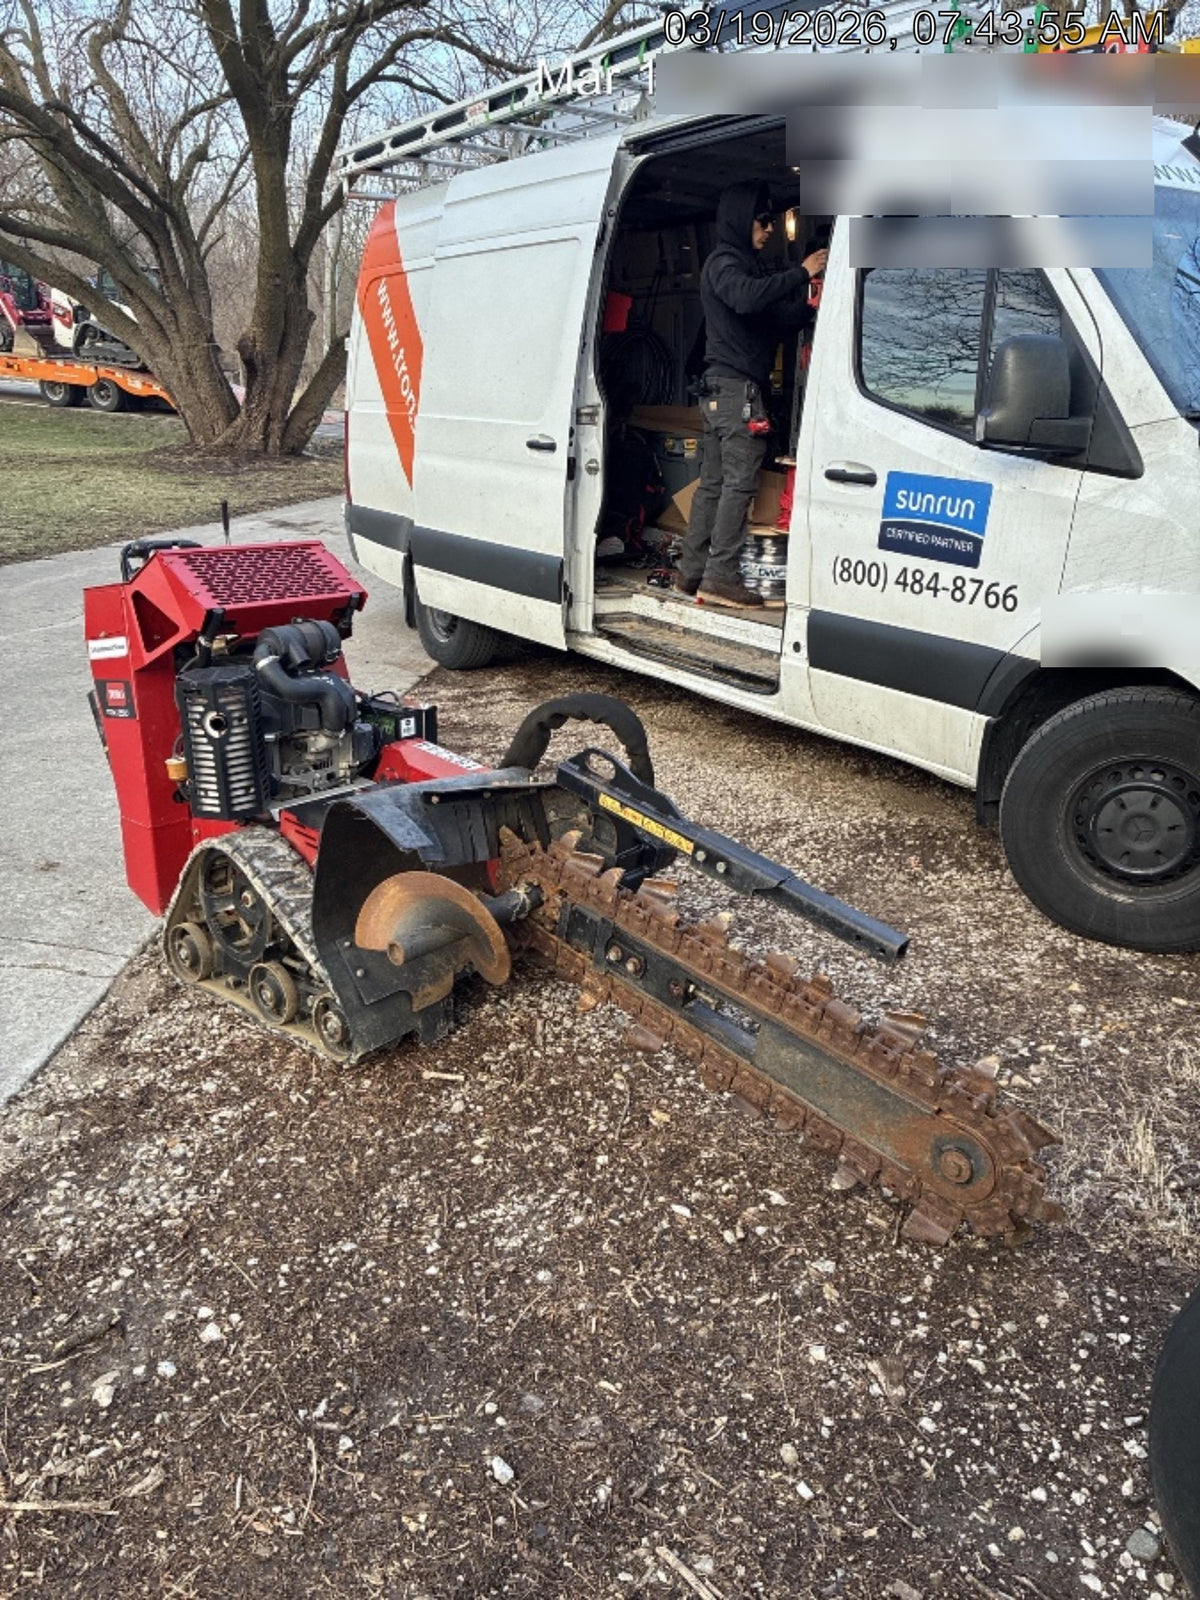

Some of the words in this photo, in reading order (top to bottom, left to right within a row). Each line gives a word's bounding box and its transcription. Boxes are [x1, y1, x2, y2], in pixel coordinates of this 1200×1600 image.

[895, 489, 976, 520] sunrun
[885, 527, 930, 545] CERTIFIED
[931, 534, 974, 553] PARTNER
[832, 555, 888, 593] (800)
[894, 566, 1019, 613] 484-8766
